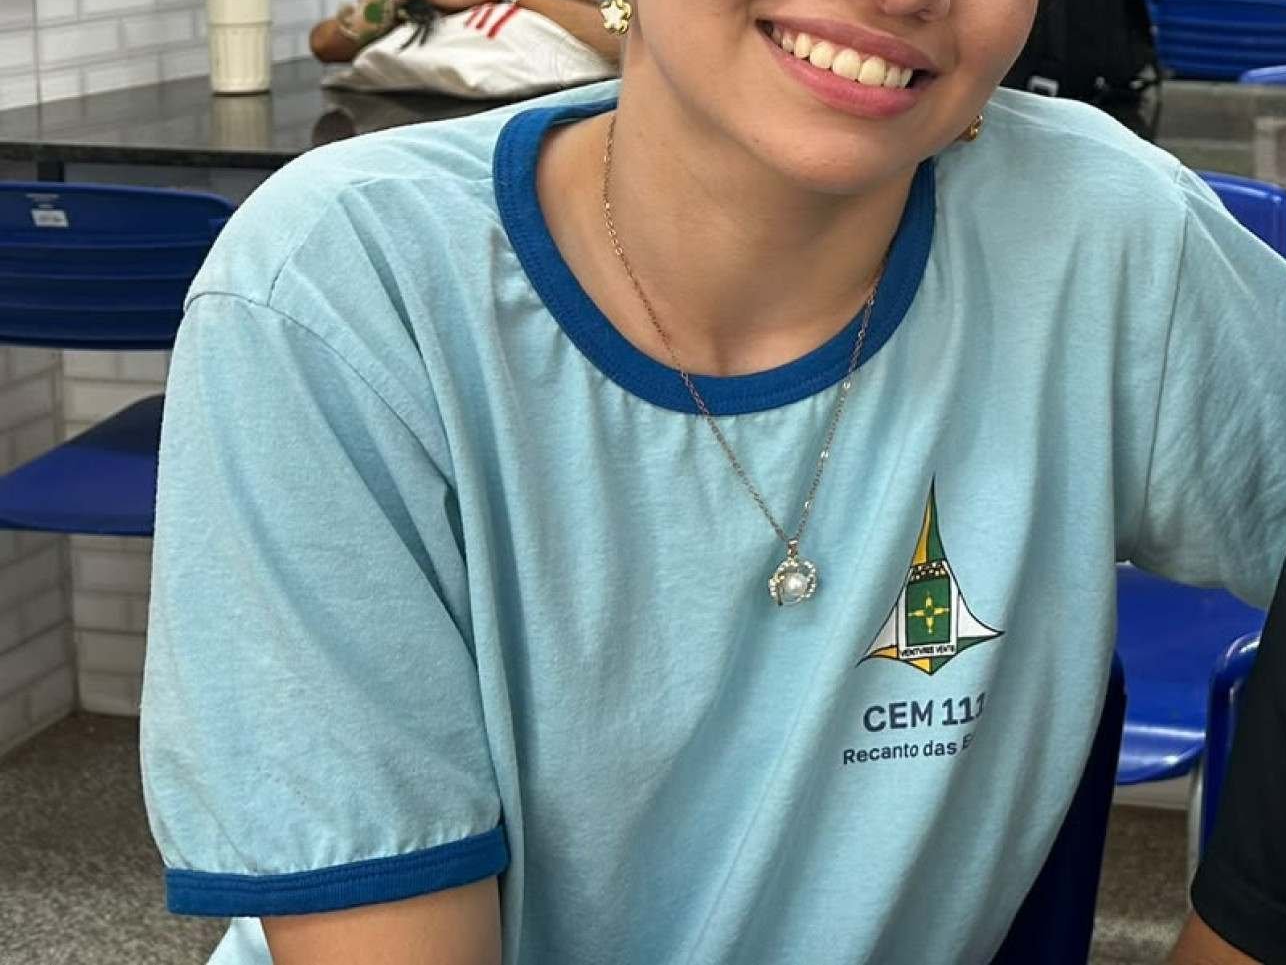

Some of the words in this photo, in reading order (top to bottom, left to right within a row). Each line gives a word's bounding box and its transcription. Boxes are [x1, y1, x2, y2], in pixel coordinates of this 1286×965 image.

[863, 699, 934, 733] CEM
[941, 691, 986, 726] 111
[843, 742, 919, 765] Recanto
[923, 740, 957, 757] das
